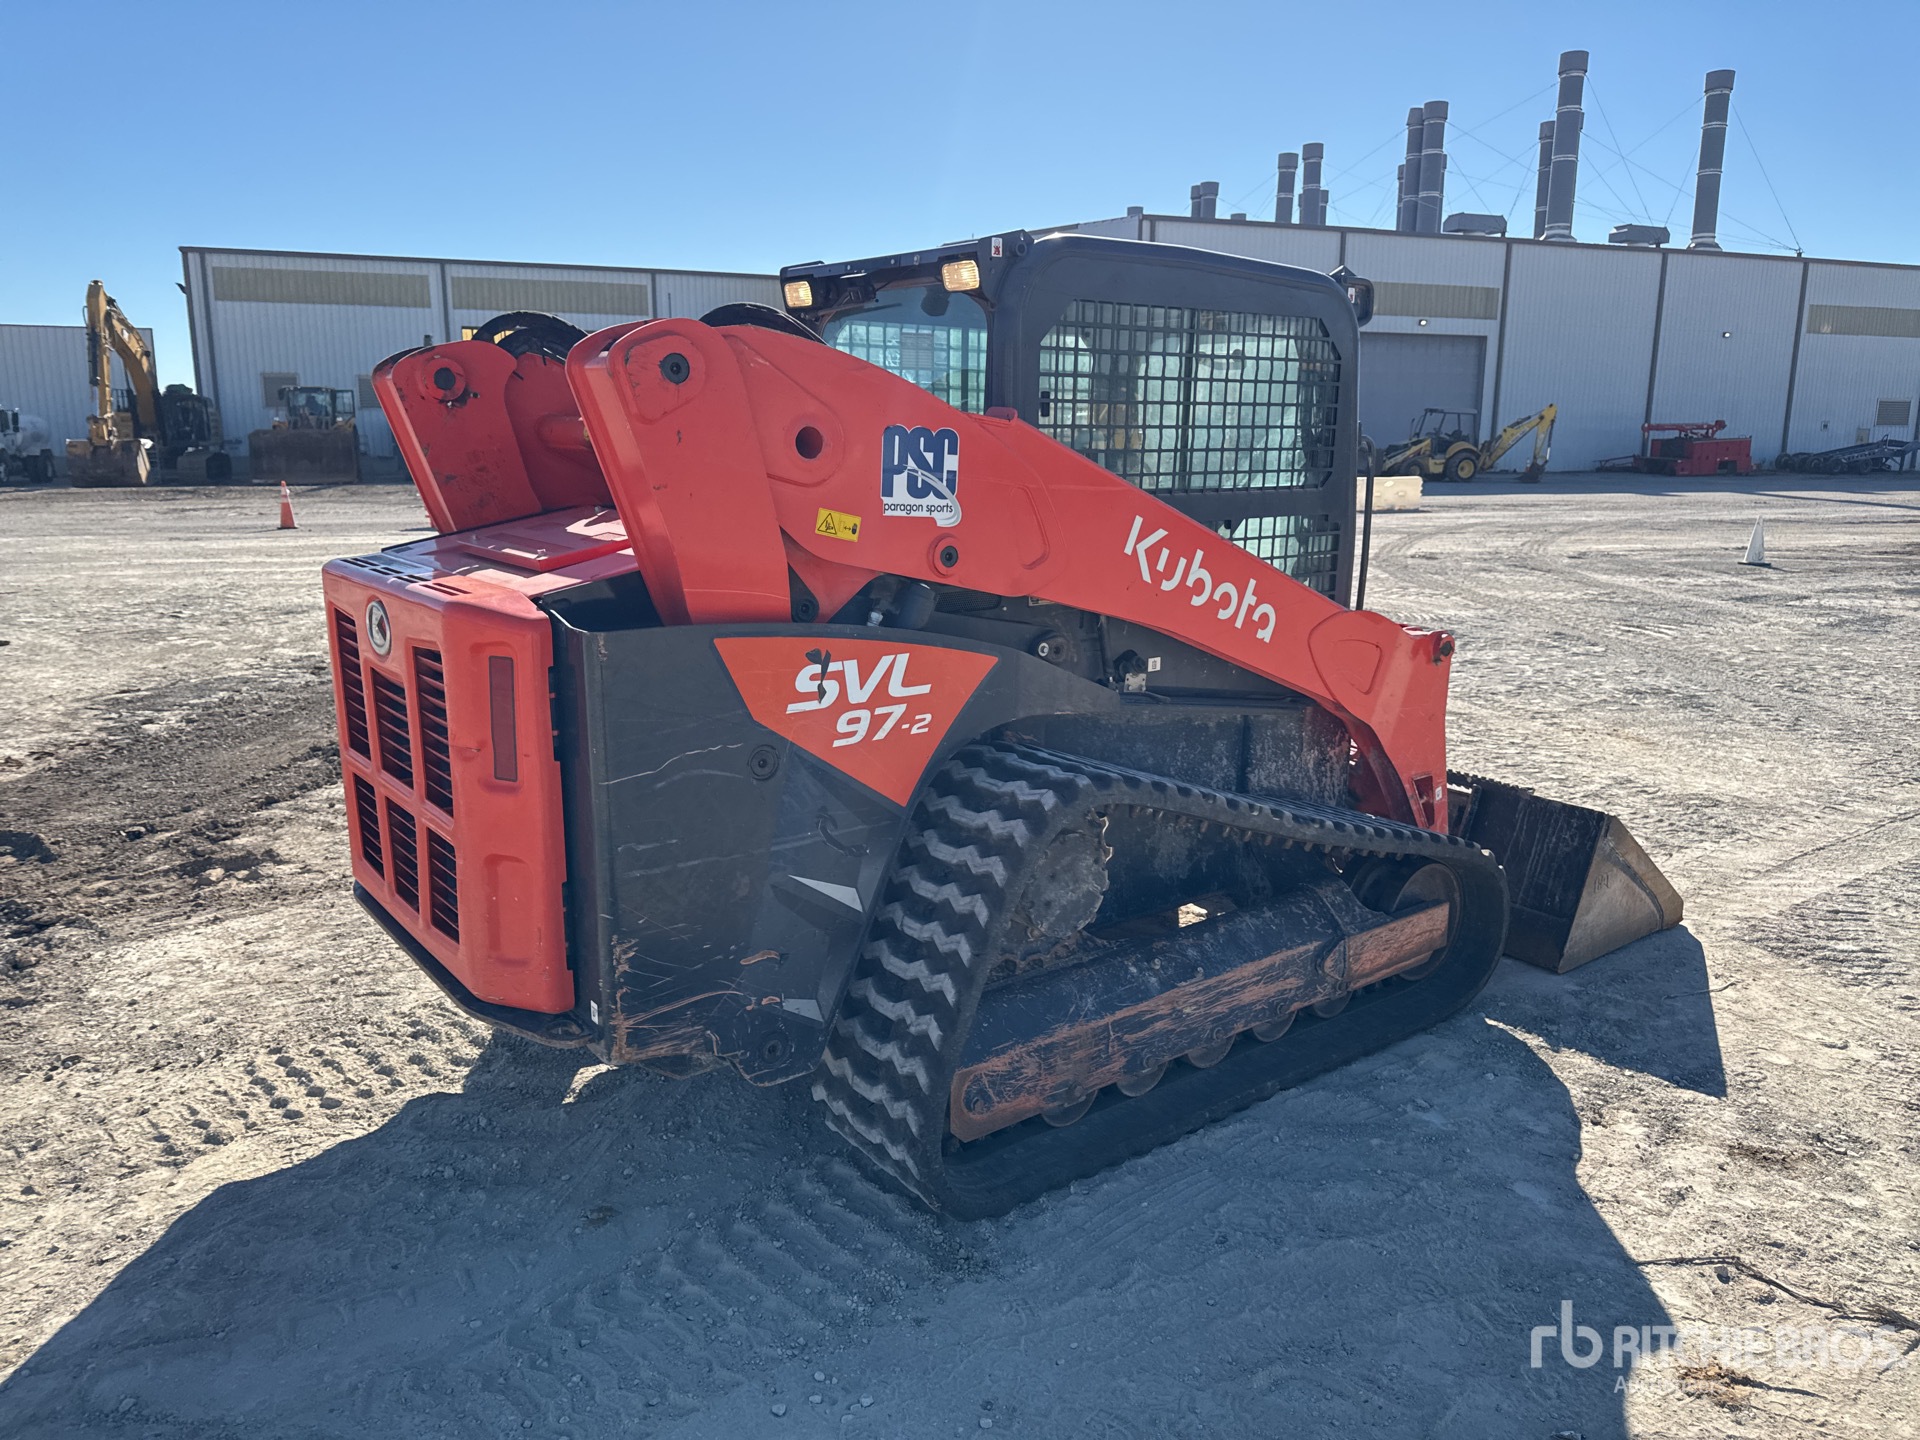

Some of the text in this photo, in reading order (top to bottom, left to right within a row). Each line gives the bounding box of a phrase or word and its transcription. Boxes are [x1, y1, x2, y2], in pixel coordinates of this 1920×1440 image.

[883, 502, 953, 515] paragon sports
[1123, 515, 1276, 643] Kubota
[786, 653, 932, 714] SVL
[832, 703, 932, 748] 97-2
